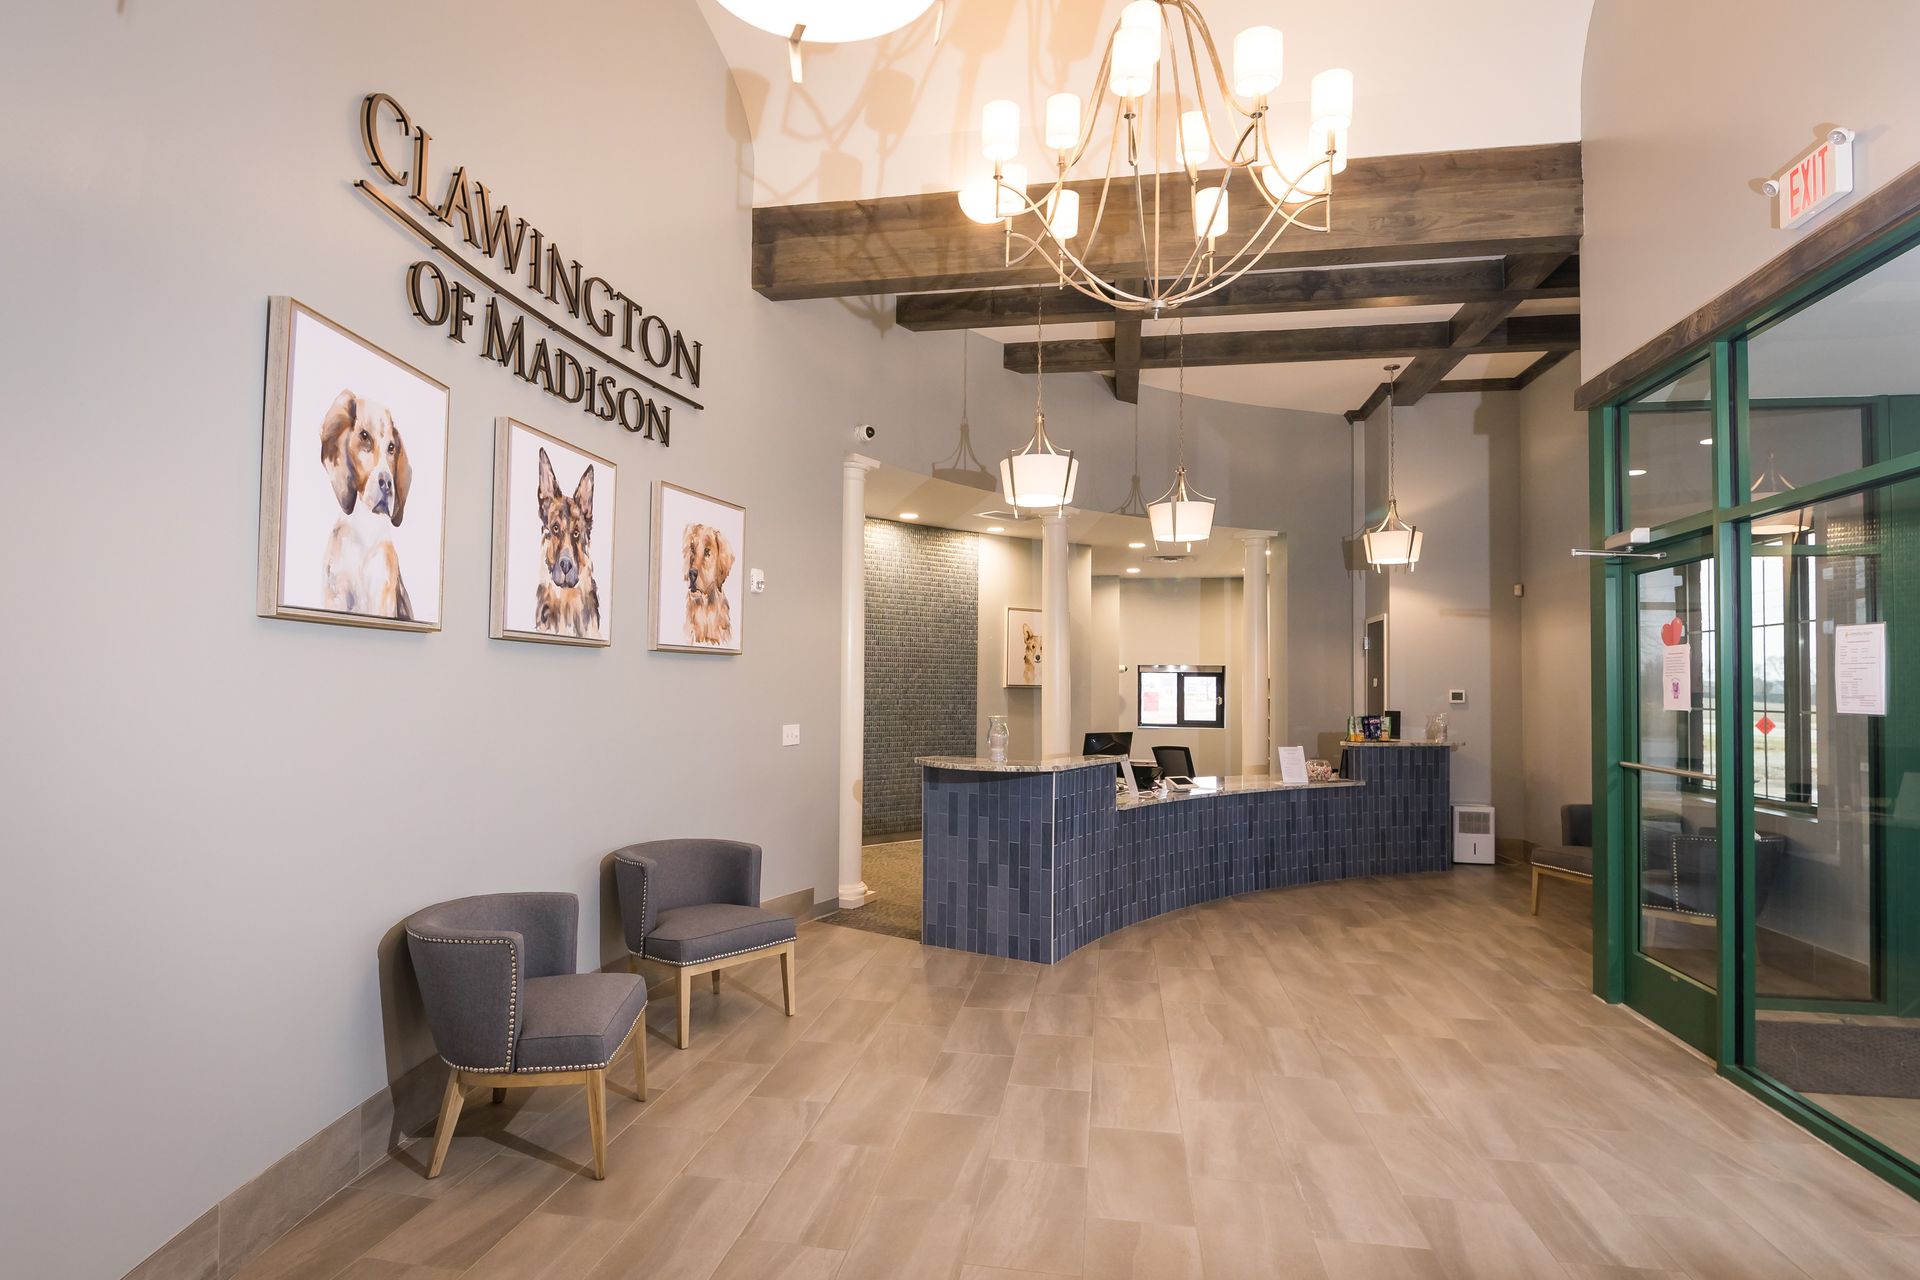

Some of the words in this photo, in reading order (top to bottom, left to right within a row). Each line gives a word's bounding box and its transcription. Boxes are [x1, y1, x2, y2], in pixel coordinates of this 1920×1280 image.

[360, 93, 703, 388] CLAWINGTON
[1789, 145, 1828, 218] EXIT
[406, 260, 476, 343] OF
[479, 297, 672, 447] MADISON
